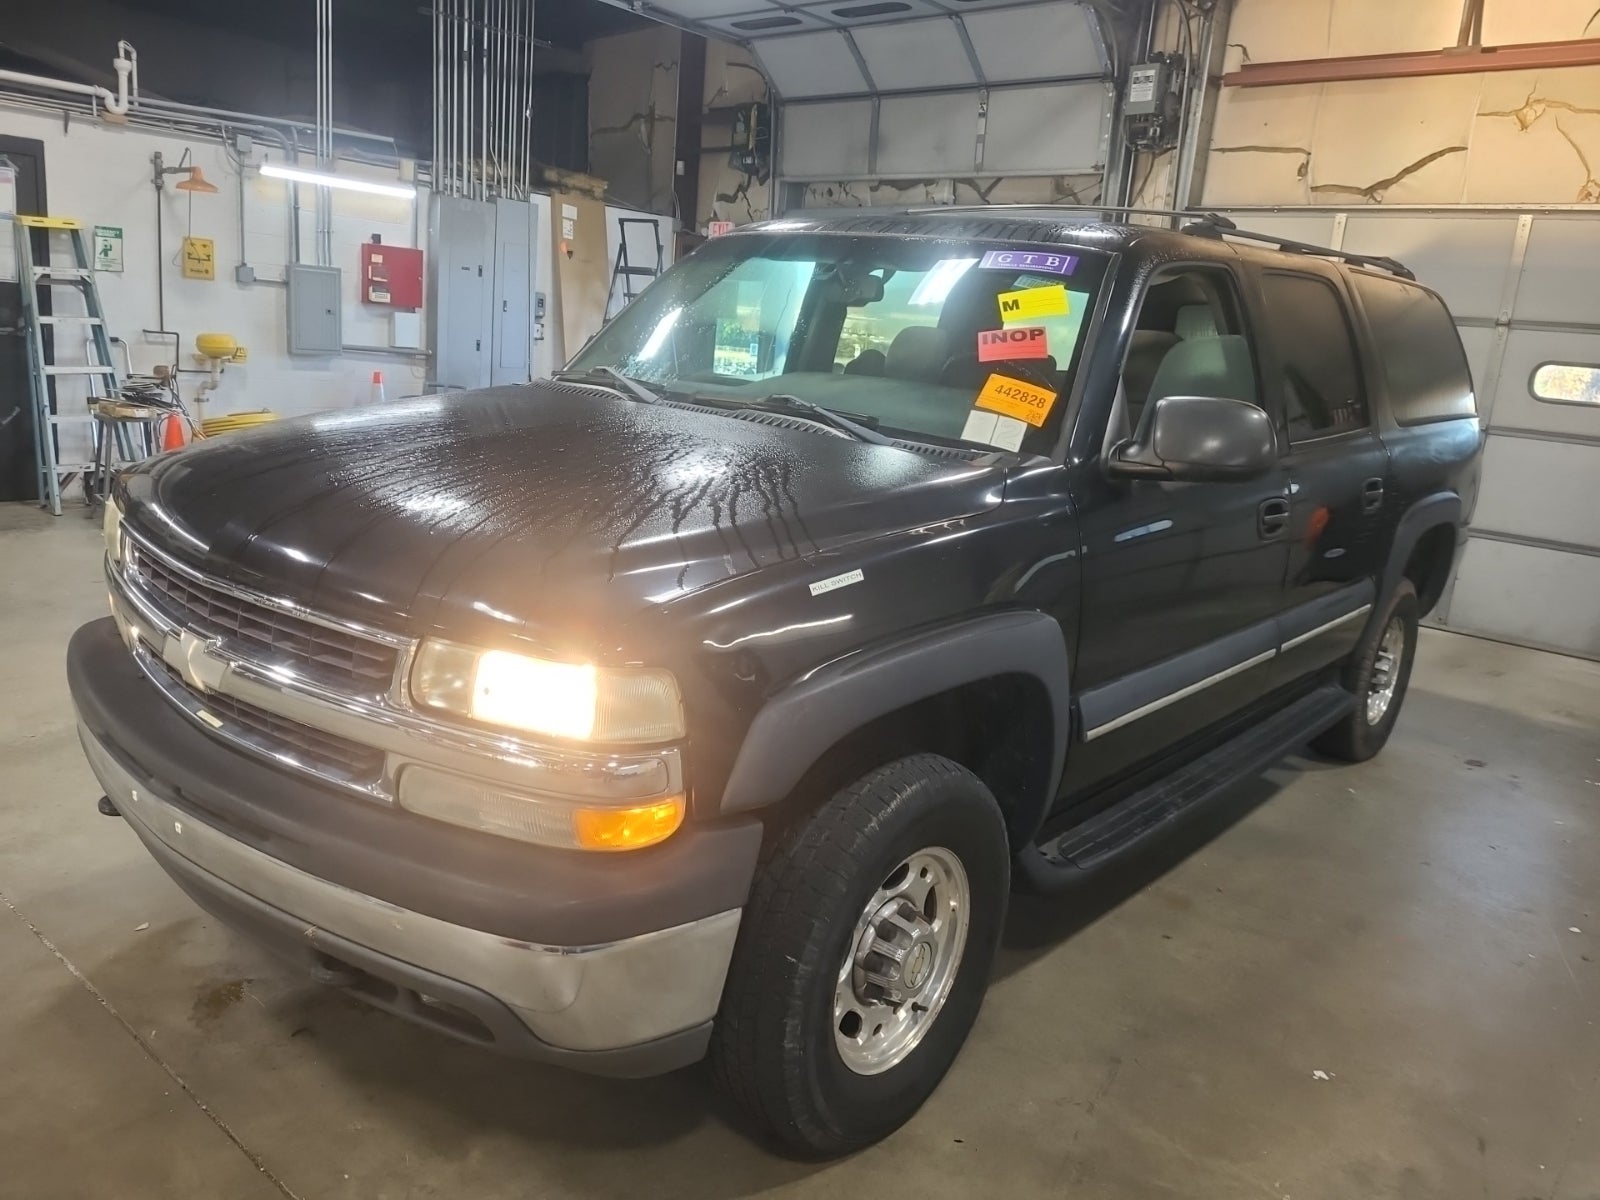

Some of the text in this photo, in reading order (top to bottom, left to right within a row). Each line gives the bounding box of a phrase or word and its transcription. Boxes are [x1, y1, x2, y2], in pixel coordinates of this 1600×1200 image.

[1001, 299, 1020, 312] M
[981, 328, 1044, 345] INOP
[994, 384, 1046, 409] 442828
[812, 572, 862, 592] KILL SWITCH
